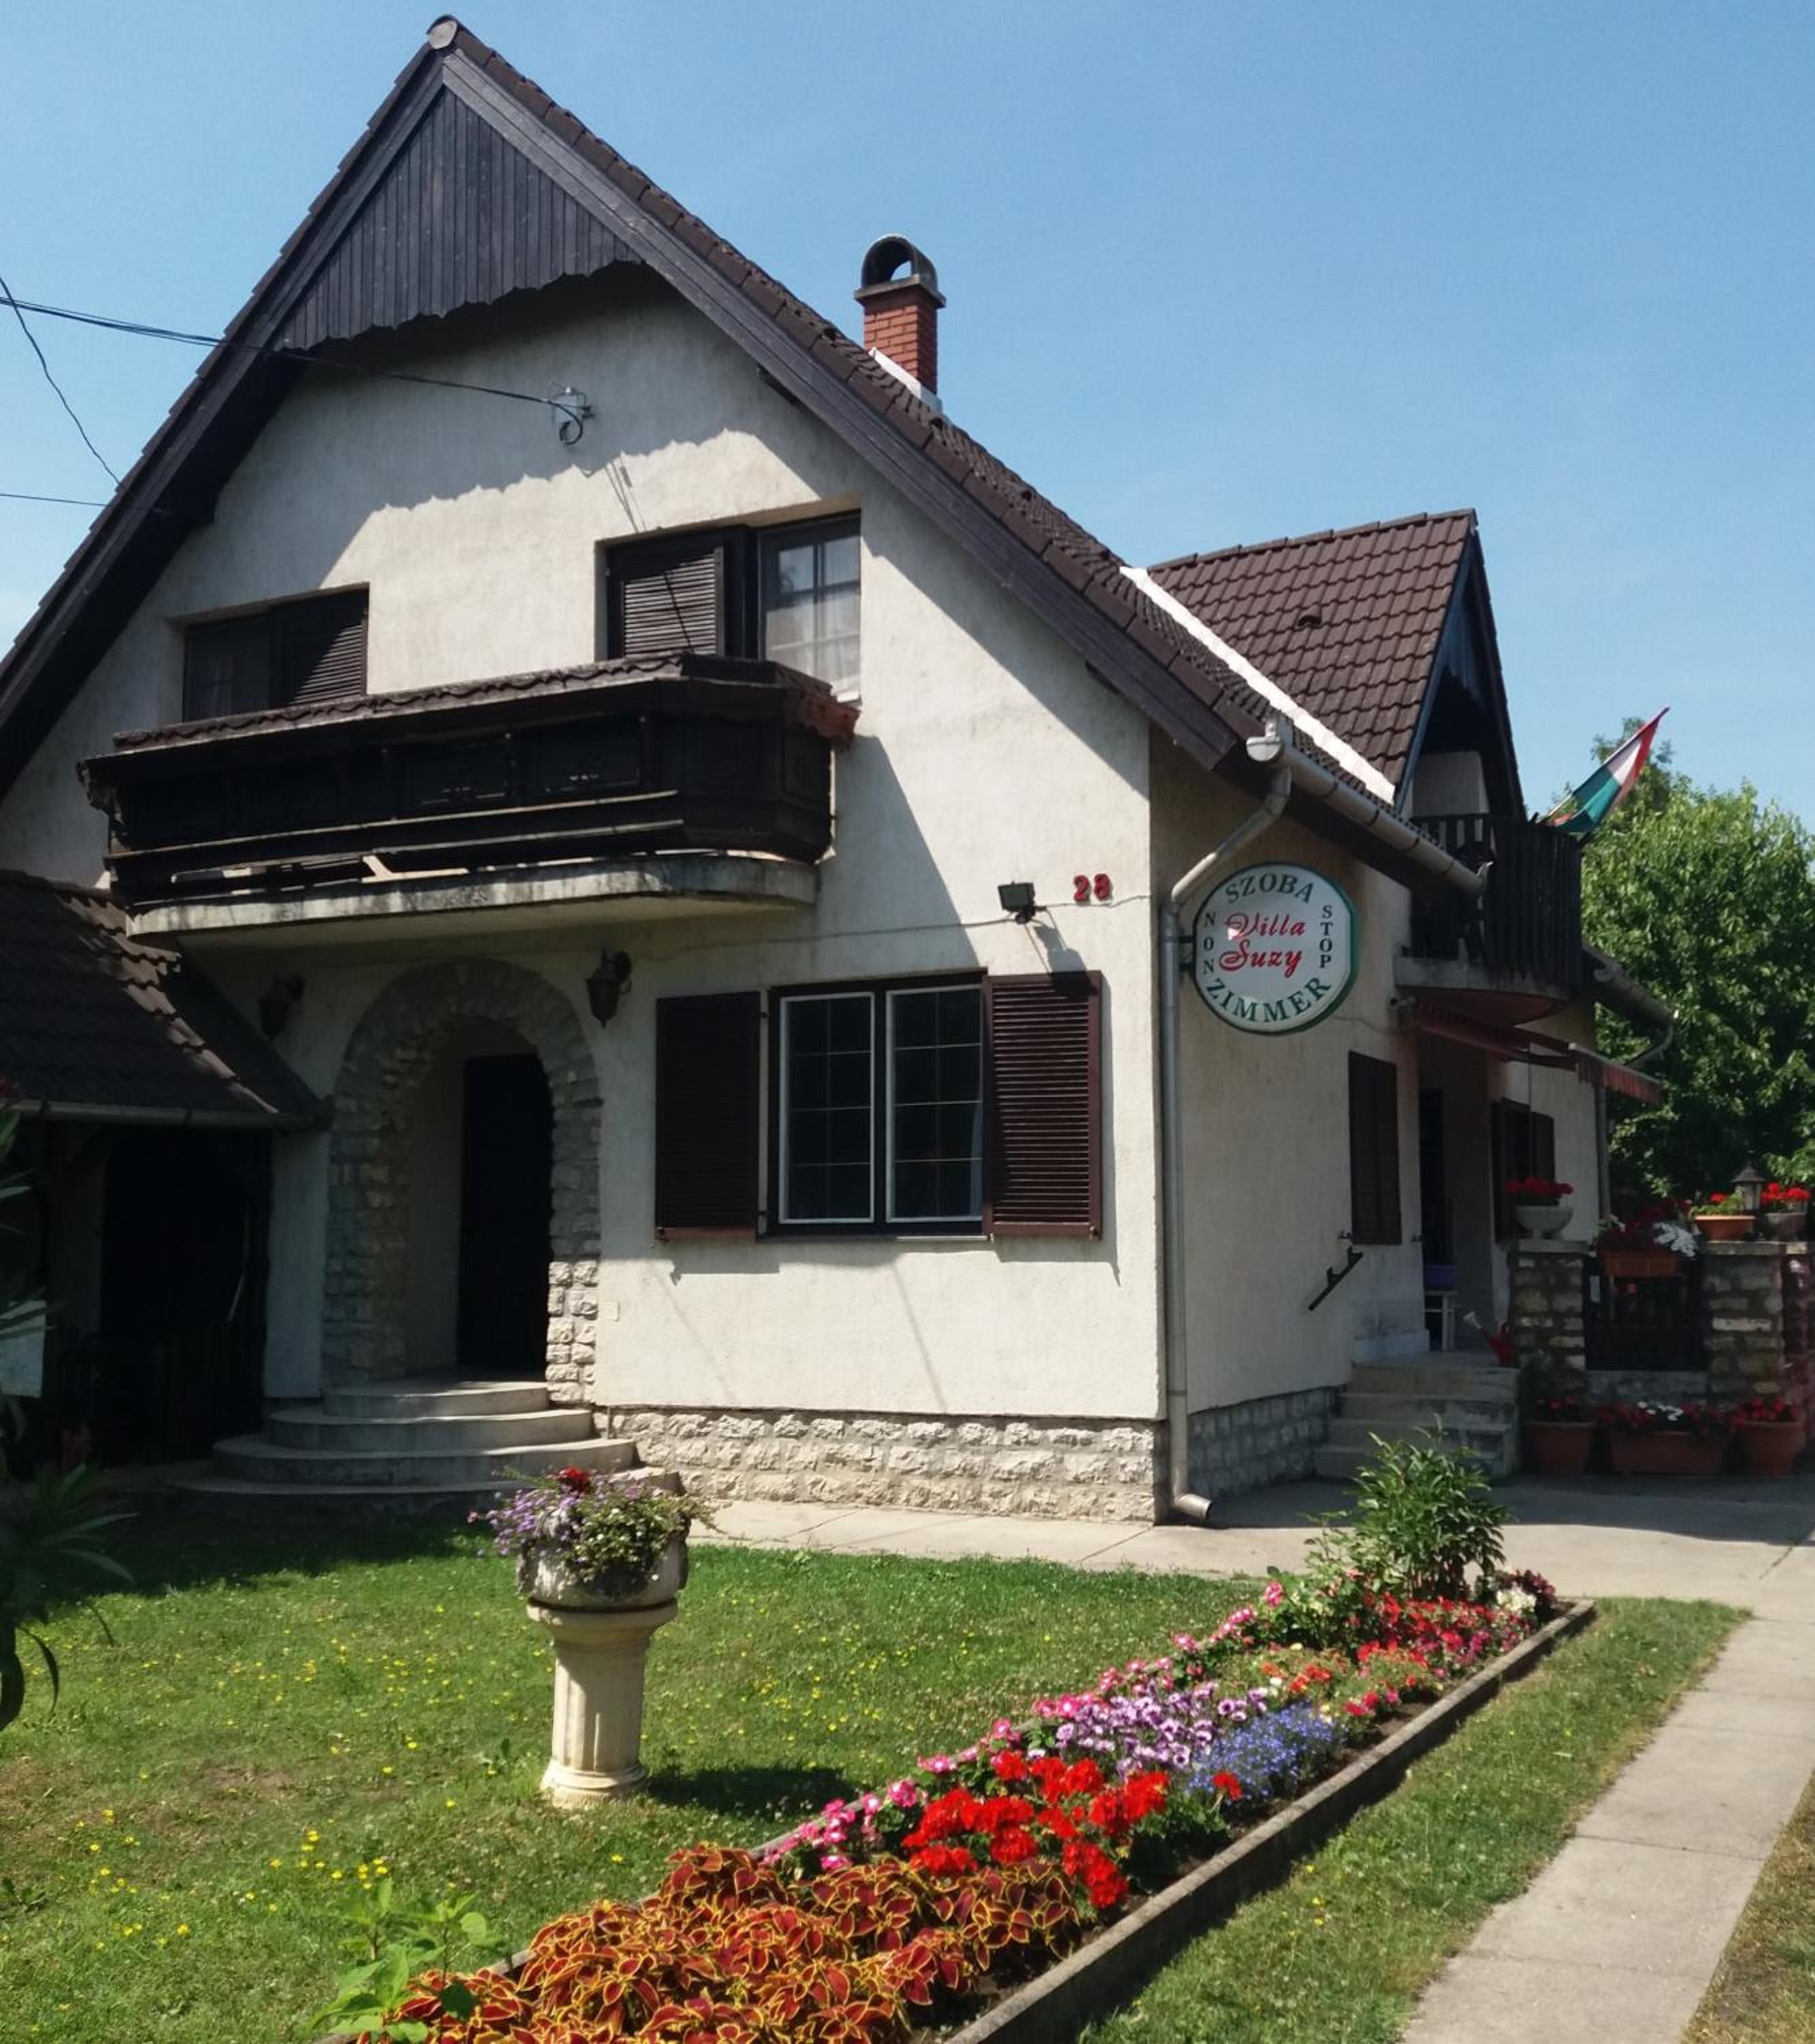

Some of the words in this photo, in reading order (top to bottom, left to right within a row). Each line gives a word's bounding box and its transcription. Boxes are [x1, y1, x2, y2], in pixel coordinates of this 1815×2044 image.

[1073, 873, 1111, 902] 28
[1226, 872, 1314, 903] SZOBA
[1203, 912, 1216, 974] NON
[1223, 912, 1306, 937] Villa
[1320, 905, 1333, 968] STOP
[1218, 939, 1303, 978] Suzy
[1206, 977, 1331, 1023] ZIMMER
